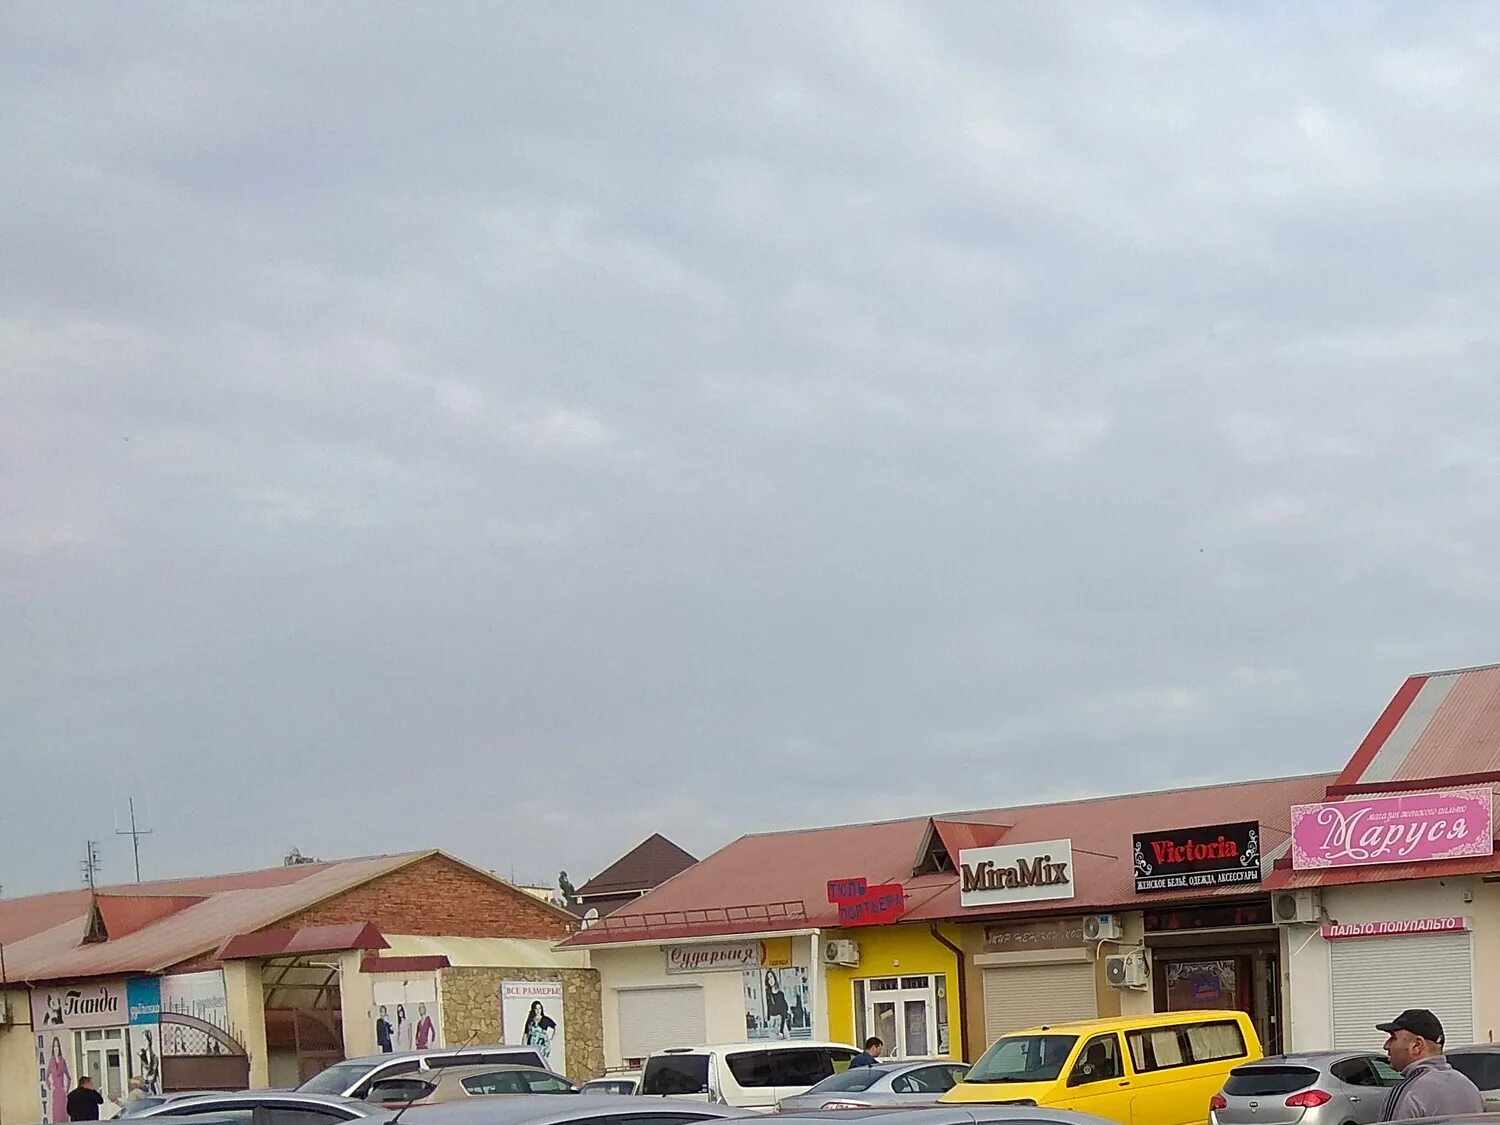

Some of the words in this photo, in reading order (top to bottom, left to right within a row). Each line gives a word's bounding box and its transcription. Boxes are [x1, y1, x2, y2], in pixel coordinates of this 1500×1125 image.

[1317, 807, 1469, 860] Маруся
[1150, 836, 1239, 865] Victoria
[960, 854, 1071, 893] MiraMix
[1137, 879, 1166, 890] ЖЕНСКОЕ
[1167, 875, 1188, 888] БЕЛЬЁ,
[1189, 875, 1217, 885] ОДЕЖДА,
[1217, 870, 1258, 883] АКСЕССУАРЫ
[1330, 922, 1378, 937] ПАЛЬТО,
[1379, 918, 1456, 933] ПОЛУПАЛЬТО
[671, 947, 754, 969] Сударыня
[64, 986, 119, 1016] Панда
[506, 987, 520, 995] ВСЕ
[522, 986, 561, 995] РАЗМЕРЫ!
[37, 1034, 50, 1125] ПАЛЬТО
